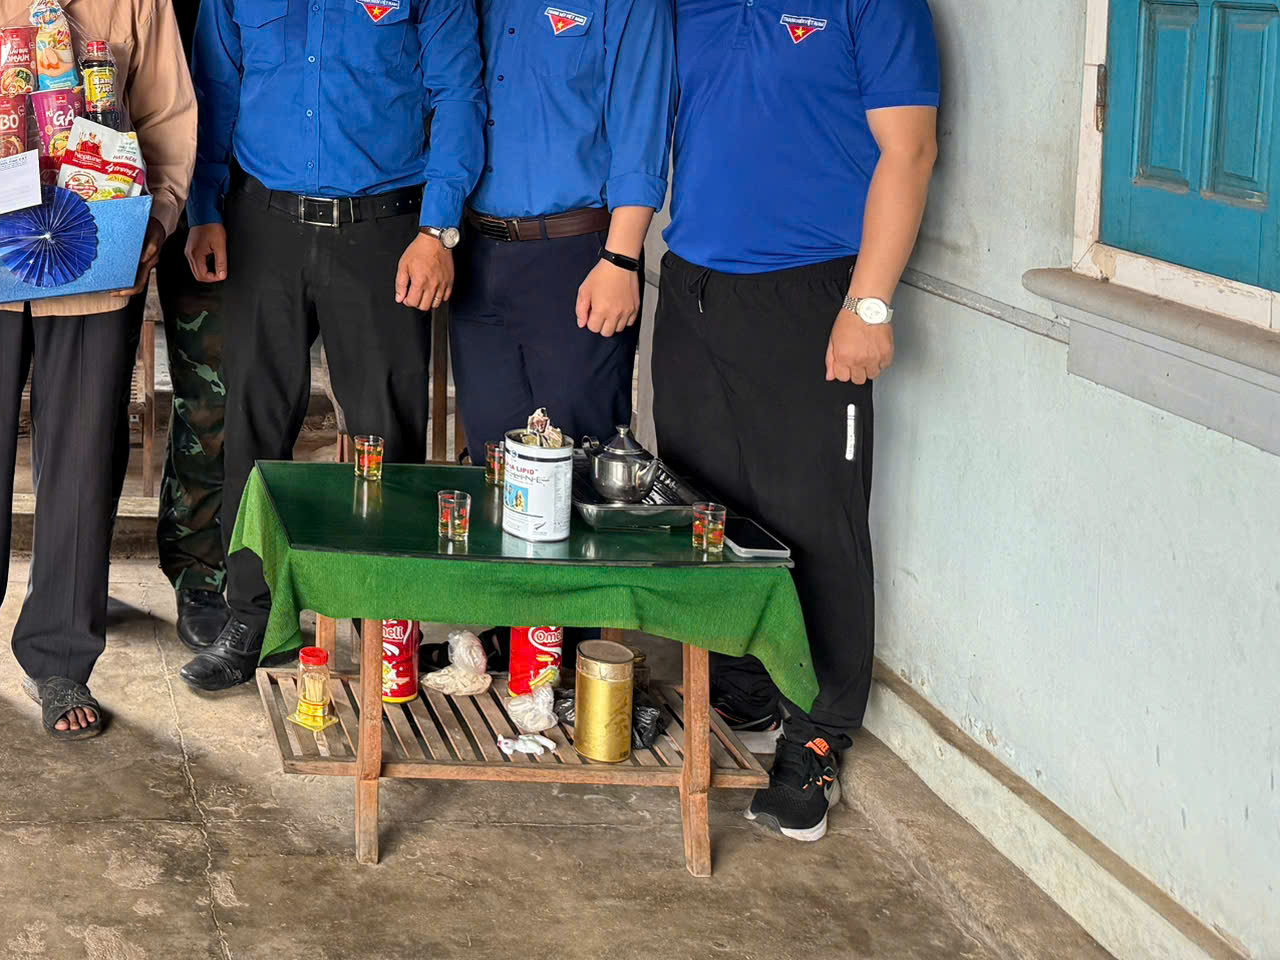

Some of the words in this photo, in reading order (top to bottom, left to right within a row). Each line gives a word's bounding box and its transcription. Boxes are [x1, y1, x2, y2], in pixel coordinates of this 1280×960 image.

[53, 104, 75, 127] GÀ
[105, 162, 114, 173] 4
[516, 465, 535, 476] LIPID
[534, 630, 562, 643] Ome
